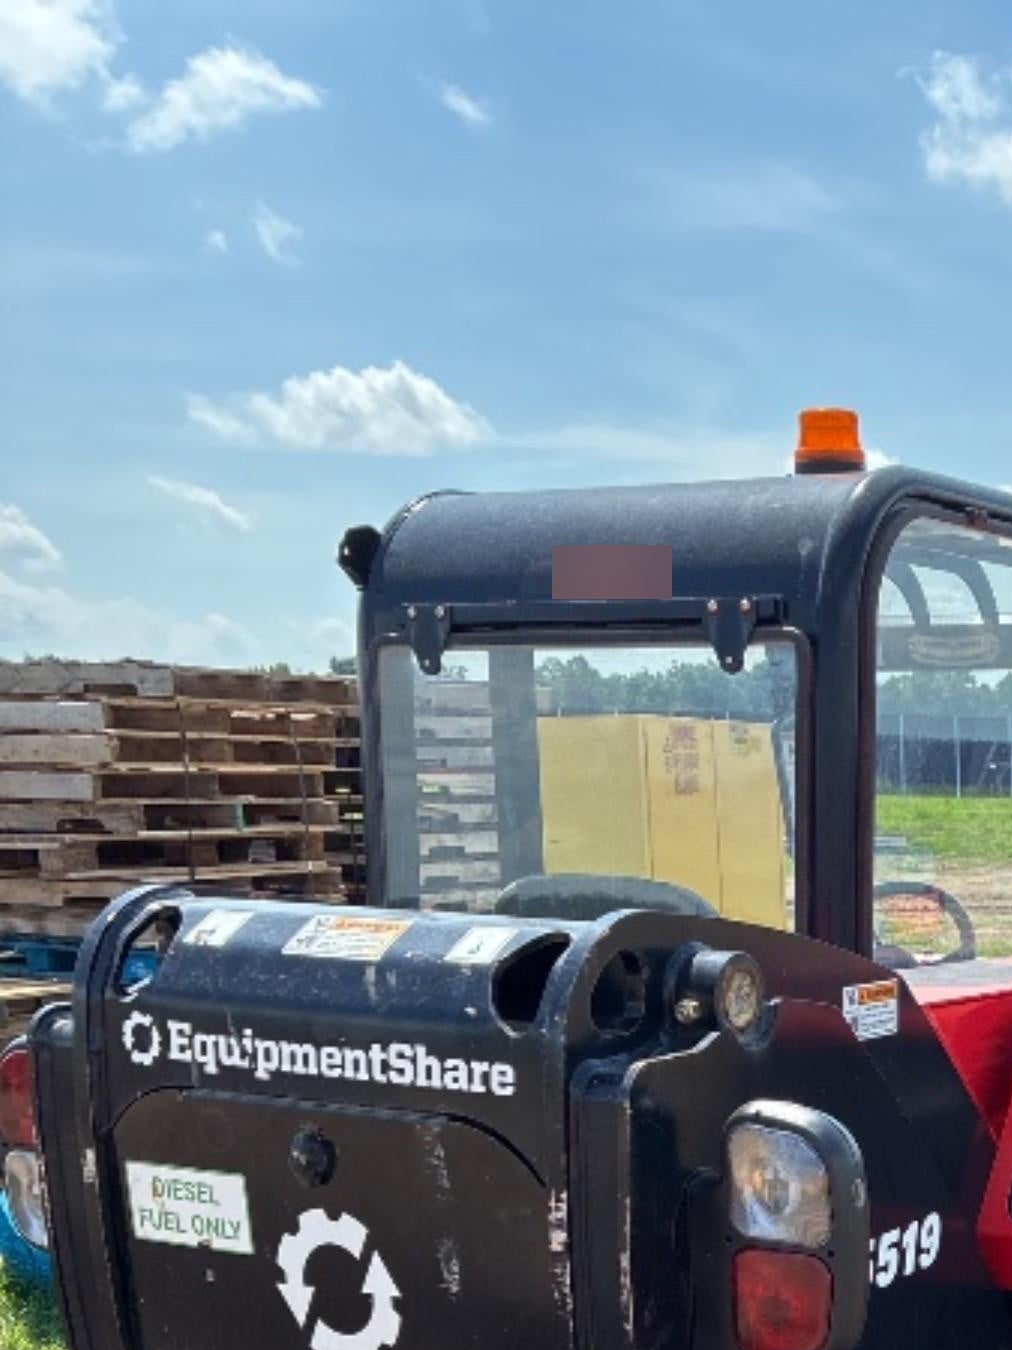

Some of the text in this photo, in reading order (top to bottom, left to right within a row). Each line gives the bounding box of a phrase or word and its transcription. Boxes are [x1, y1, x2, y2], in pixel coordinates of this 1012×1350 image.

[166, 1019, 516, 1096] EquipmentShare
[151, 1175, 221, 1206] DIESEL
[139, 1207, 241, 1240] FUEL ONLY
[869, 1211, 943, 1289] 519
